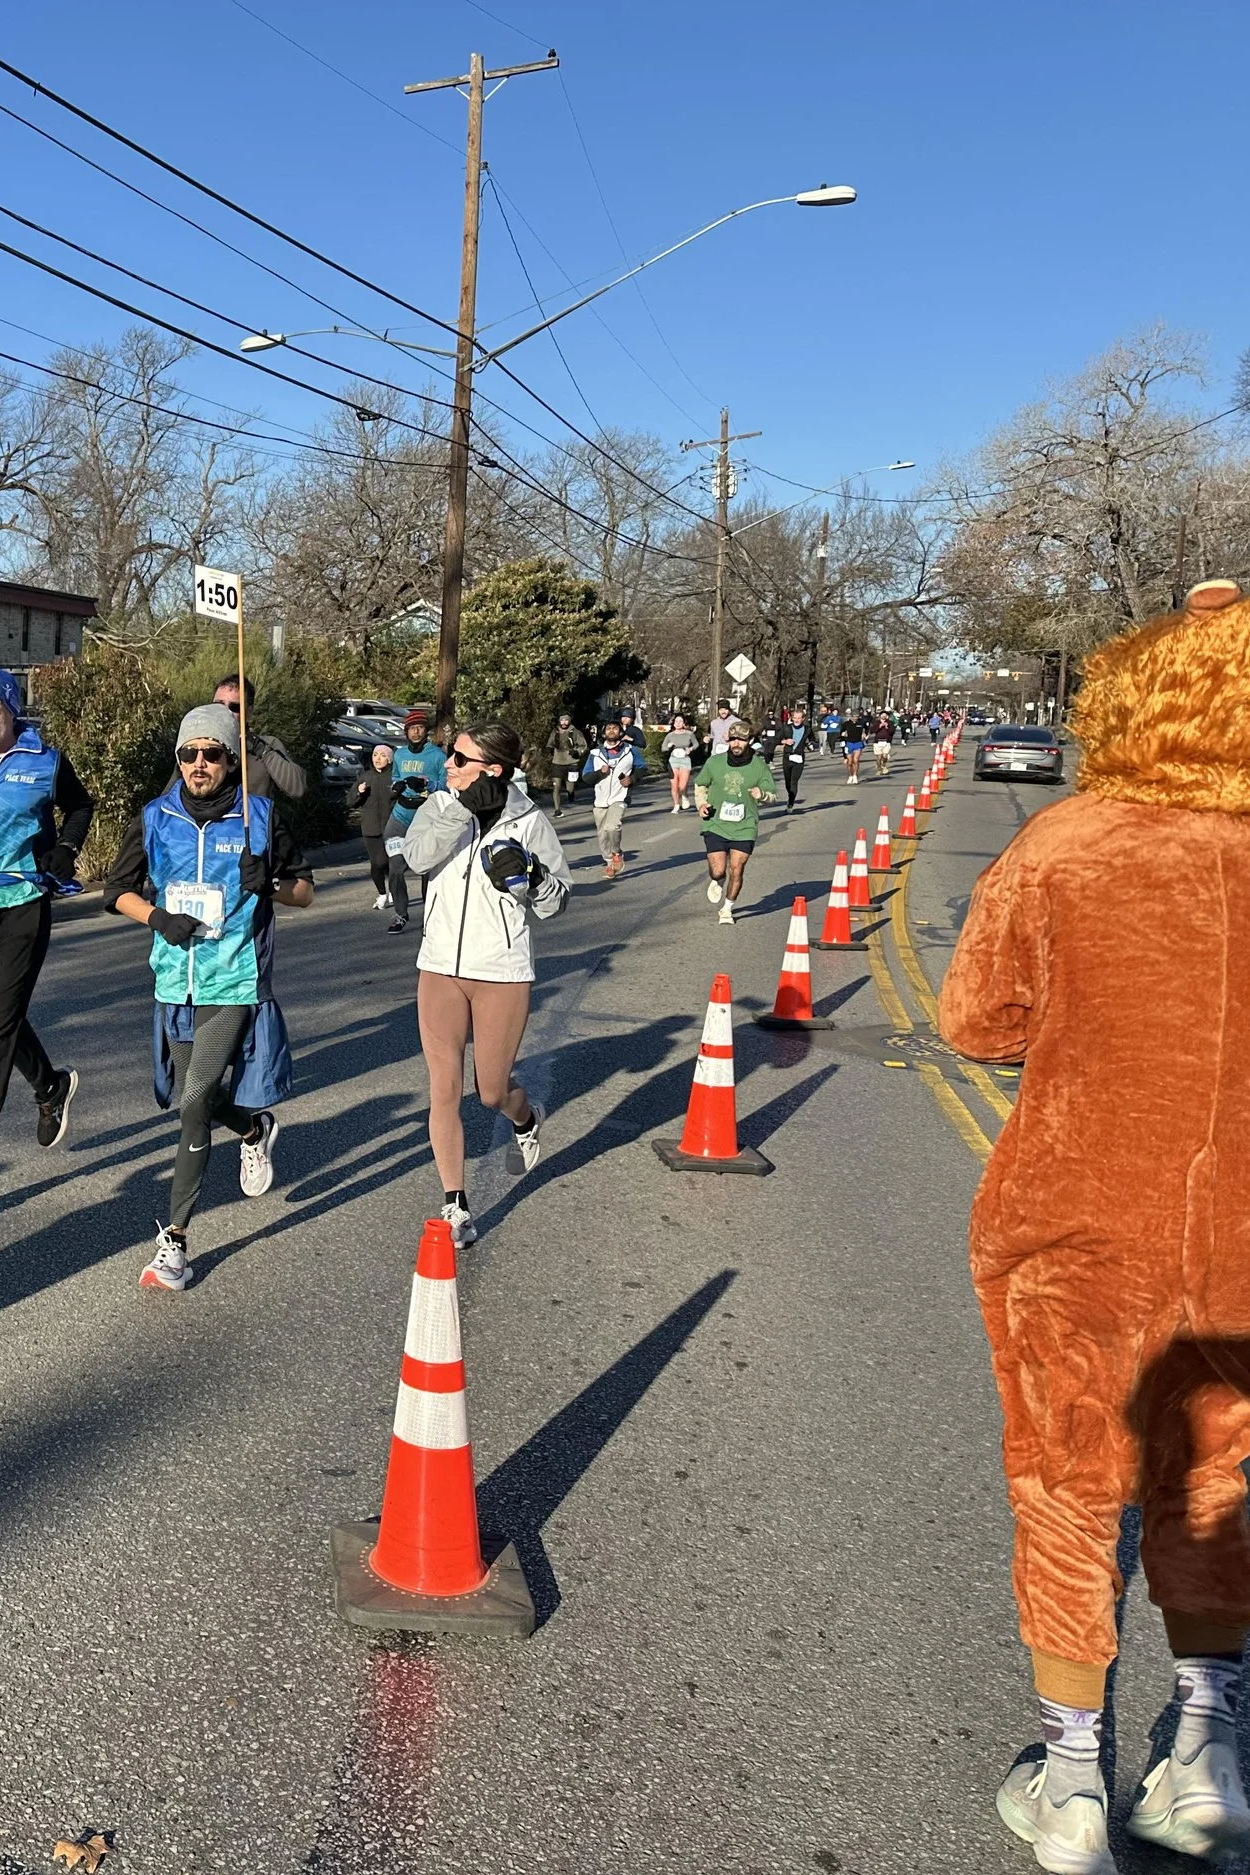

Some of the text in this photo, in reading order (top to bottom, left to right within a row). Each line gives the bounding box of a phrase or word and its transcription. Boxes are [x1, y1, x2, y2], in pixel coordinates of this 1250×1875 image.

[196, 578, 238, 610] 1:50
[5, 774, 20, 782] PACE
[215, 844, 231, 854] PACE
